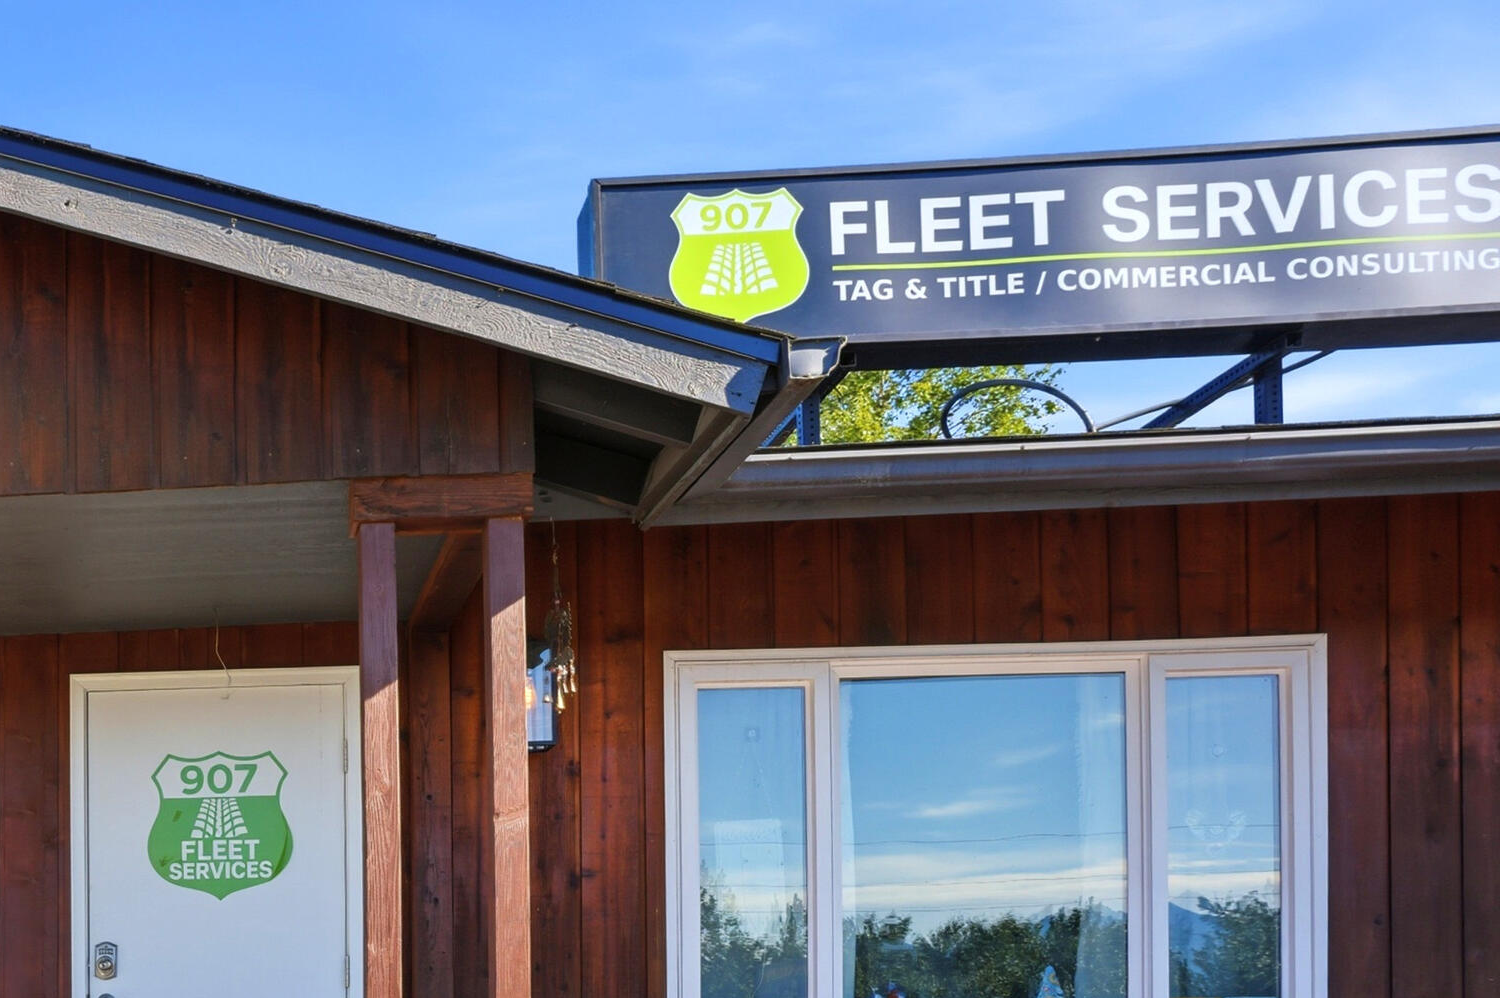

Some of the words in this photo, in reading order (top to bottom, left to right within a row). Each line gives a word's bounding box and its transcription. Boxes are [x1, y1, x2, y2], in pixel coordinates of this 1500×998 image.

[700, 201, 772, 231] 907
[829, 189, 1066, 256] FLEET
[1101, 163, 1500, 243] SERVICES
[833, 278, 894, 301] TAG
[904, 278, 927, 300] &
[937, 272, 1025, 298] TITLE
[1057, 260, 1275, 292] COMMERCIAL
[1286, 247, 1500, 281] CONSULTING
[179, 763, 258, 795] 907
[180, 838, 260, 862] FLEET
[169, 860, 273, 881] SERVICES
